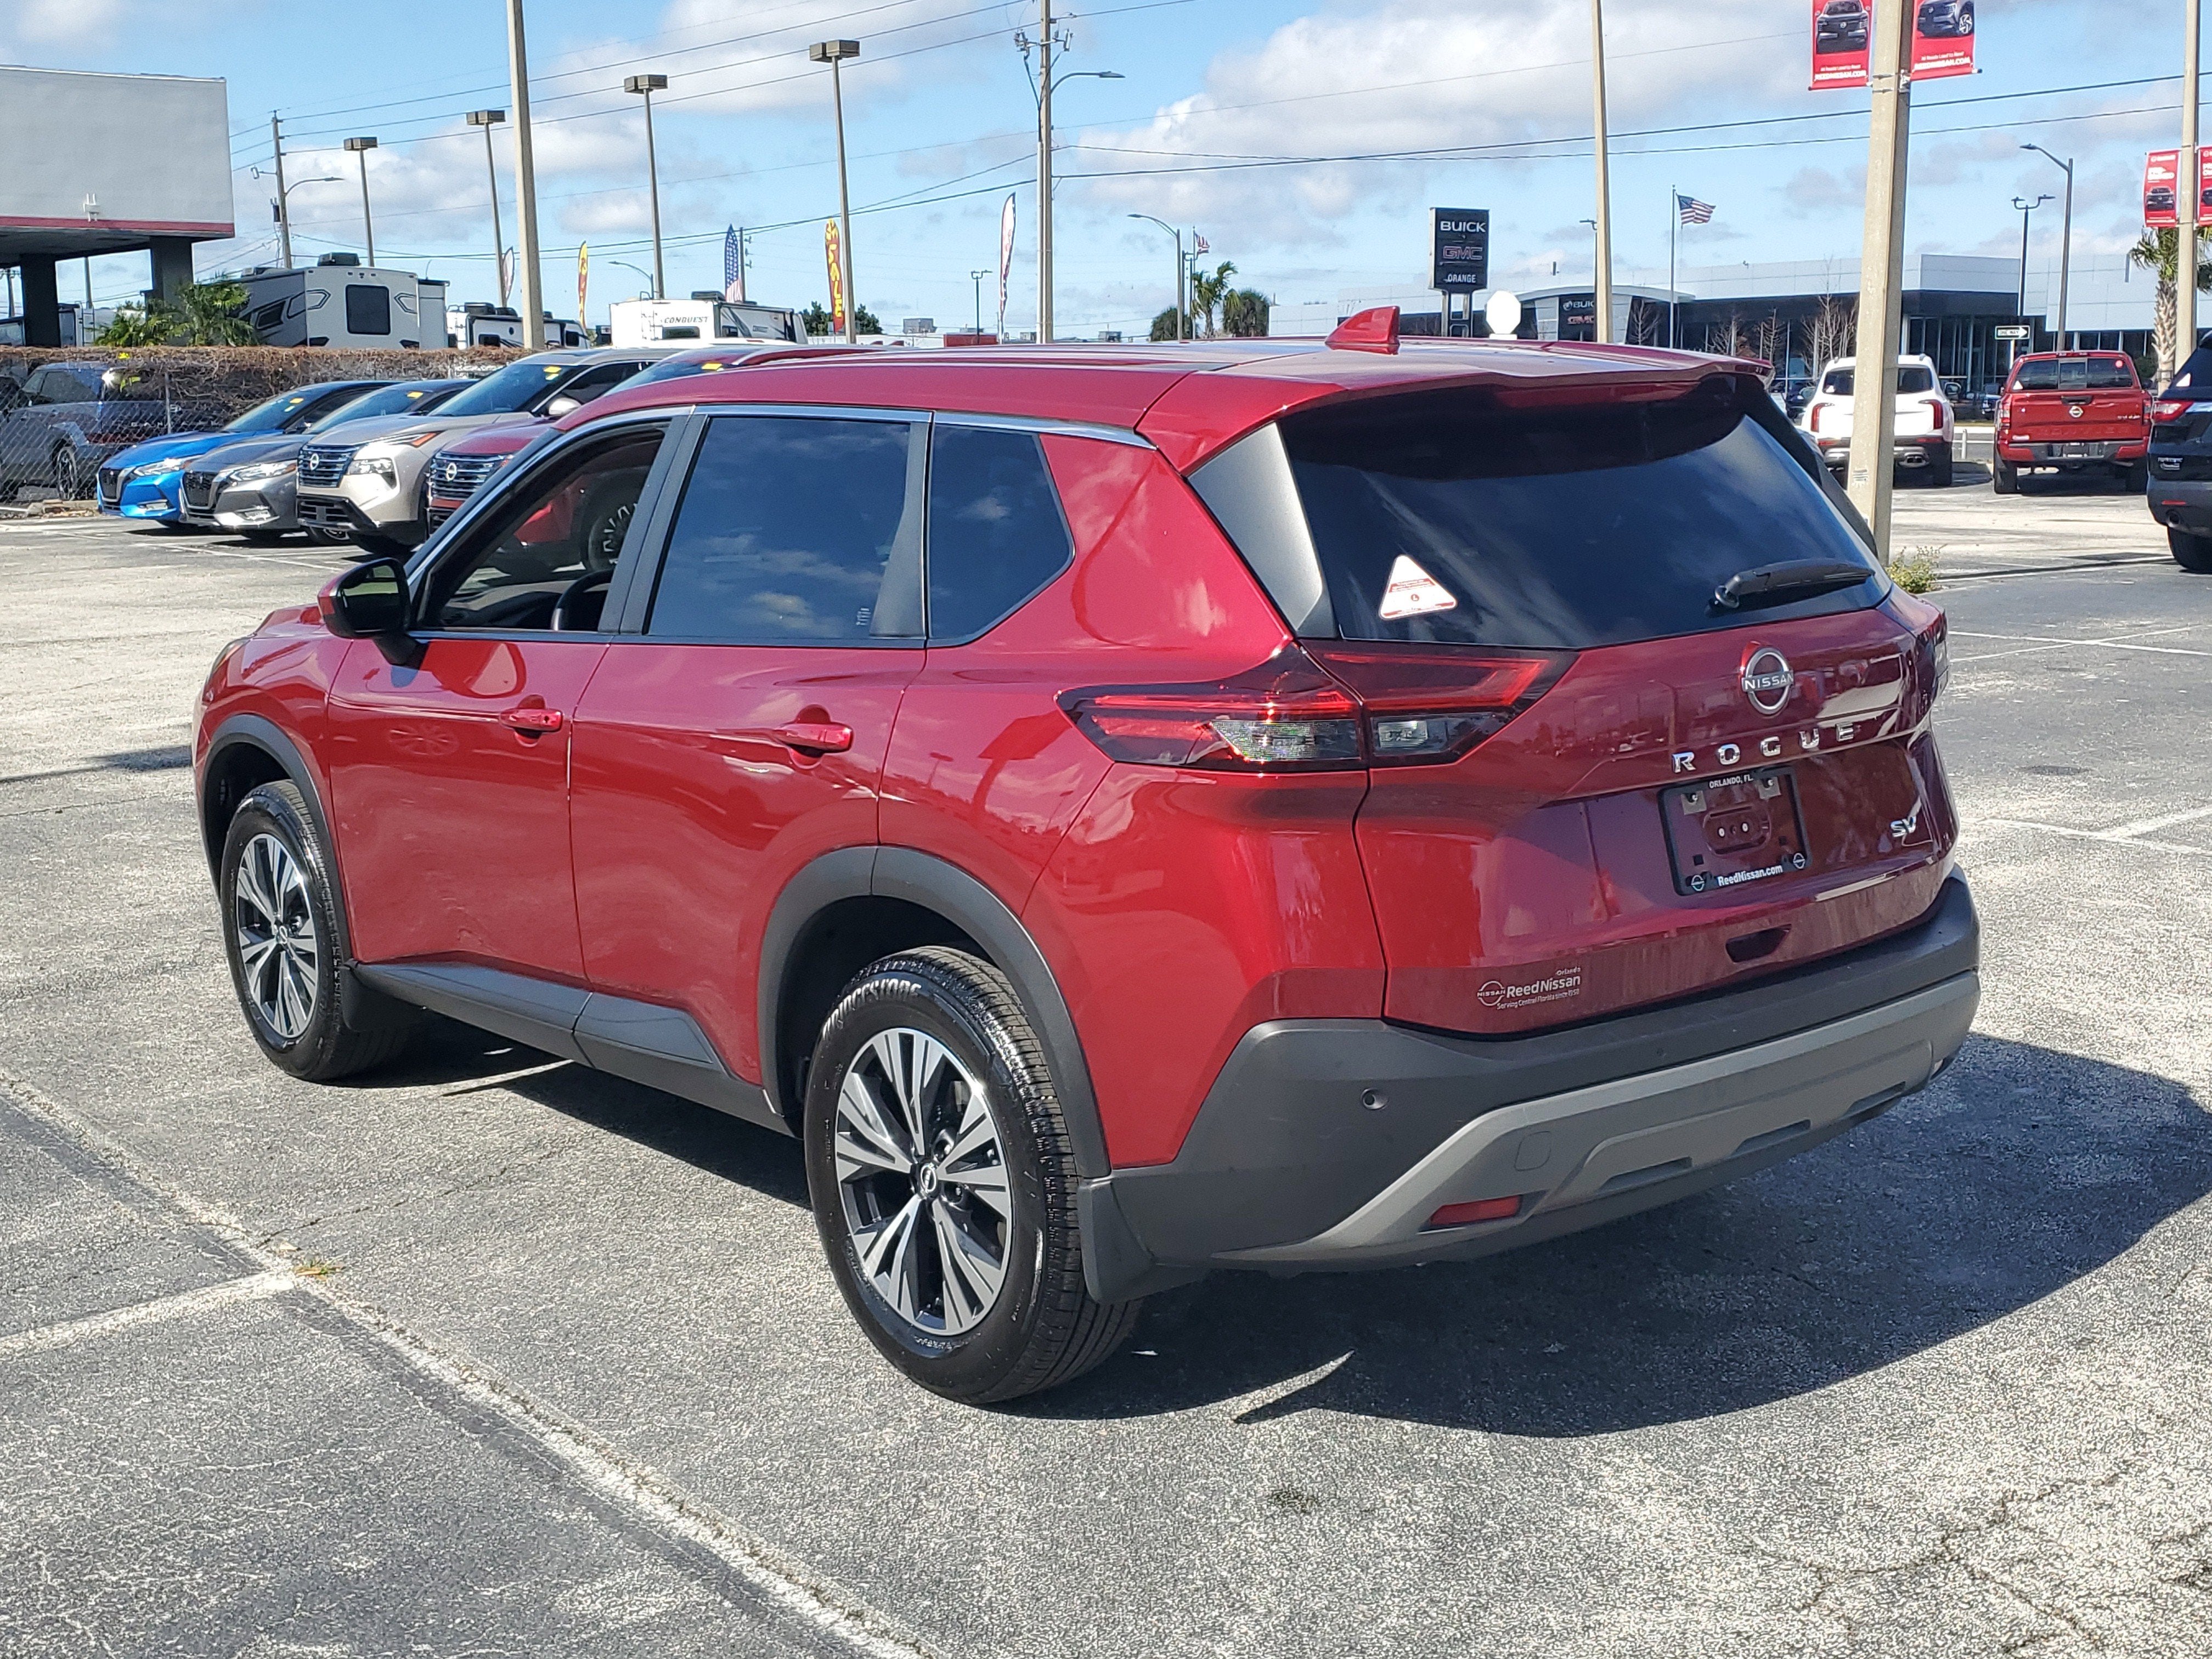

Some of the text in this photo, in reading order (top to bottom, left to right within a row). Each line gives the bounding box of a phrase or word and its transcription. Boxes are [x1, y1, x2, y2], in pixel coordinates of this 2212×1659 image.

[1440, 221, 1486, 233] BUICK
[1443, 245, 1483, 260] GMC
[828, 244, 843, 318] SALE
[1448, 274, 1476, 283] ORANGE
[1573, 300, 1595, 308] BUIC
[1745, 673, 1794, 690] NISSAN
[1672, 721, 1855, 774] ROGUE
[1709, 775, 1743, 789] ORLANDO,
[1890, 816, 1917, 837] SV
[1717, 865, 1783, 887] ReedNissan.com
[1477, 989, 1506, 997] NISSAN
